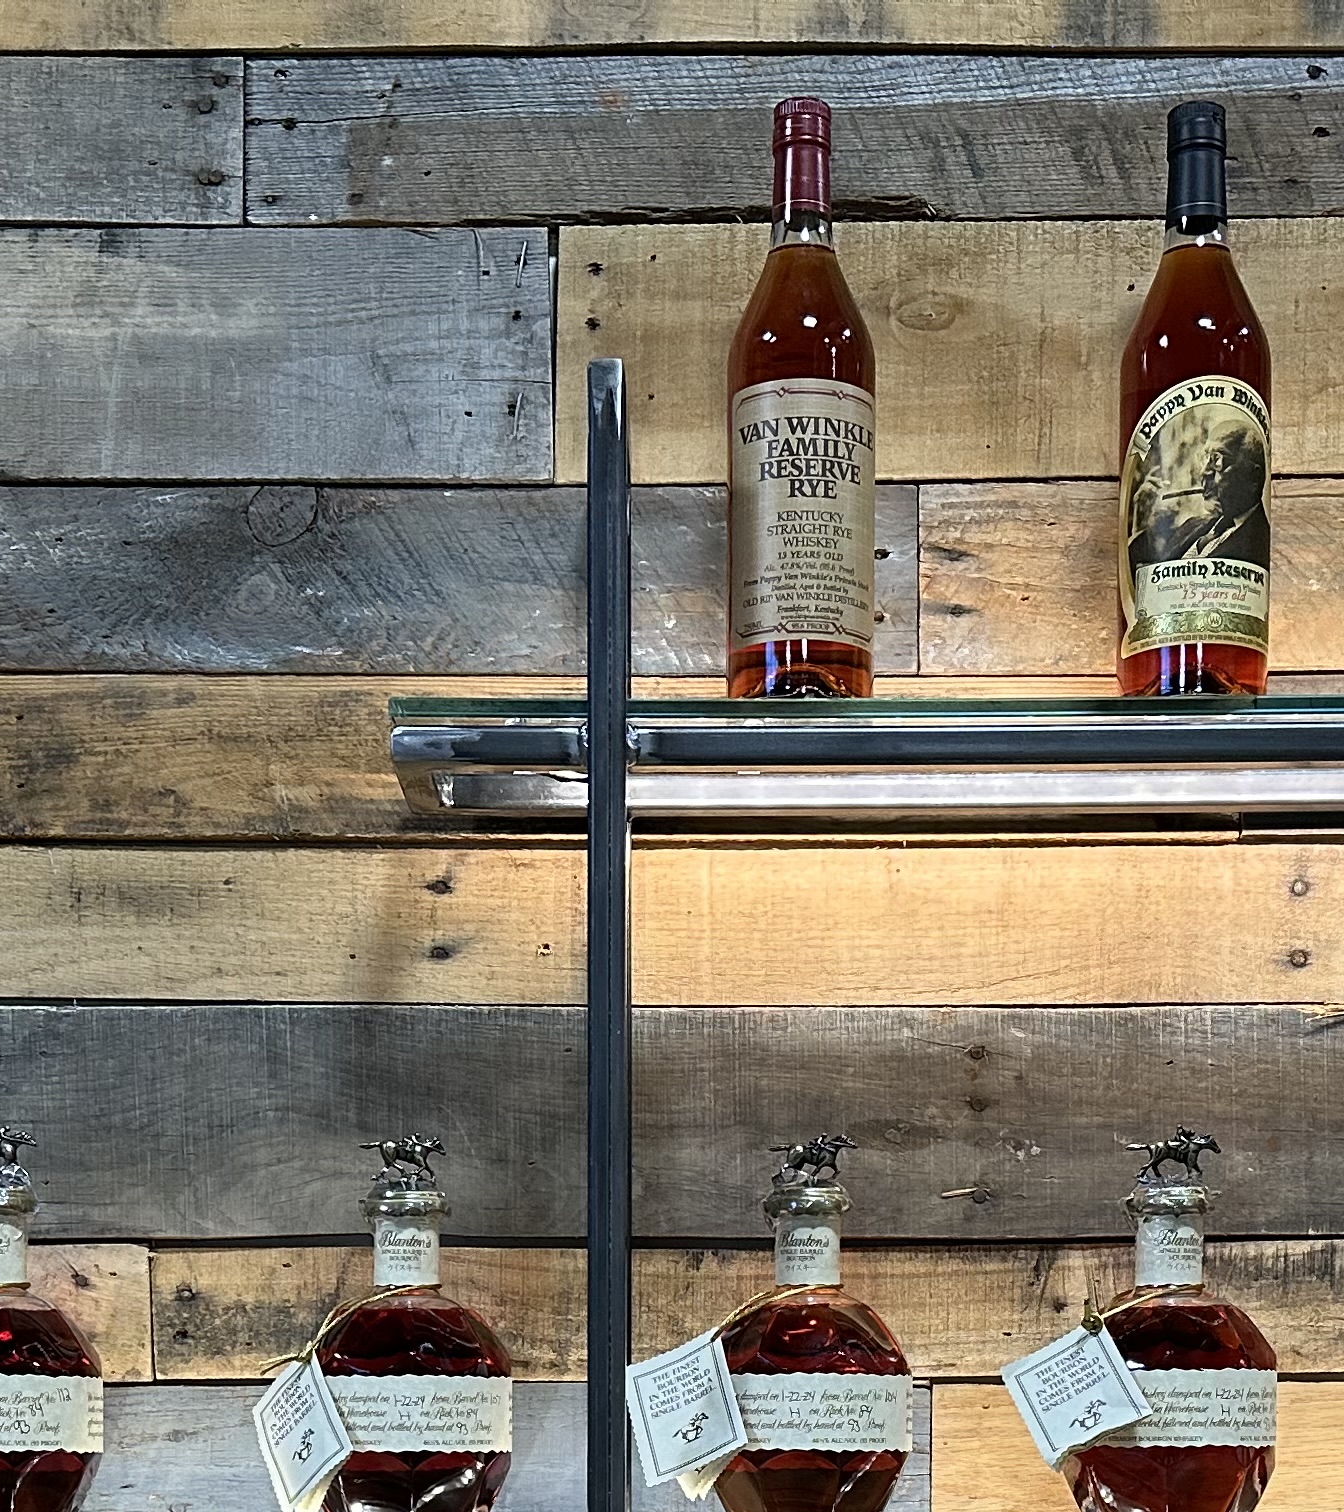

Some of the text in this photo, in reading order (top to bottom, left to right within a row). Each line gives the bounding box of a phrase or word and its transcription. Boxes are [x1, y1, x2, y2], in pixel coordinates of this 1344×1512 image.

[1187, 384, 1225, 402] Van
[739, 416, 873, 450] VAN WINKLE
[766, 437, 857, 462] FAMILY
[758, 458, 861, 485] RESERVE
[788, 479, 838, 499] RYE
[776, 510, 844, 524] KENTUCKY
[767, 523, 852, 539] STRAIGHT RYE
[783, 536, 839, 549] WHISKEY
[777, 551, 844, 562] 13 YEARS OLD
[760, 576, 782, 585] Pappy
[1151, 560, 1265, 586] Family Reserve
[742, 598, 758, 608] OLD
[775, 592, 794, 602] VAN
[796, 592, 833, 602] WINKLE
[1198, 590, 1228, 604] years
[1231, 590, 1247, 601] old
[378, 1229, 432, 1249] Blanton's
[778, 1230, 830, 1248] Blanton's
[652, 1356, 700, 1384] THE FINEST
[1034, 1345, 1085, 1378] THE FINEST
[1041, 1356, 1087, 1385] BOURBON
[656, 1366, 699, 1391] BOURBON
[661, 1386, 680, 1397] THE
[681, 1368, 710, 1388] WORLD
[1048, 1377, 1067, 1390] THE
[1067, 1357, 1099, 1378] WORLD
[649, 1395, 681, 1410] COMES
[682, 1381, 705, 1398] FROM
[1038, 1385, 1069, 1406] COMES
[1070, 1369, 1096, 1388] FROM
[651, 1402, 682, 1419] SINGLE
[1042, 1392, 1073, 1414] SINGLE
[1221, 1404, 1231, 1417] H
